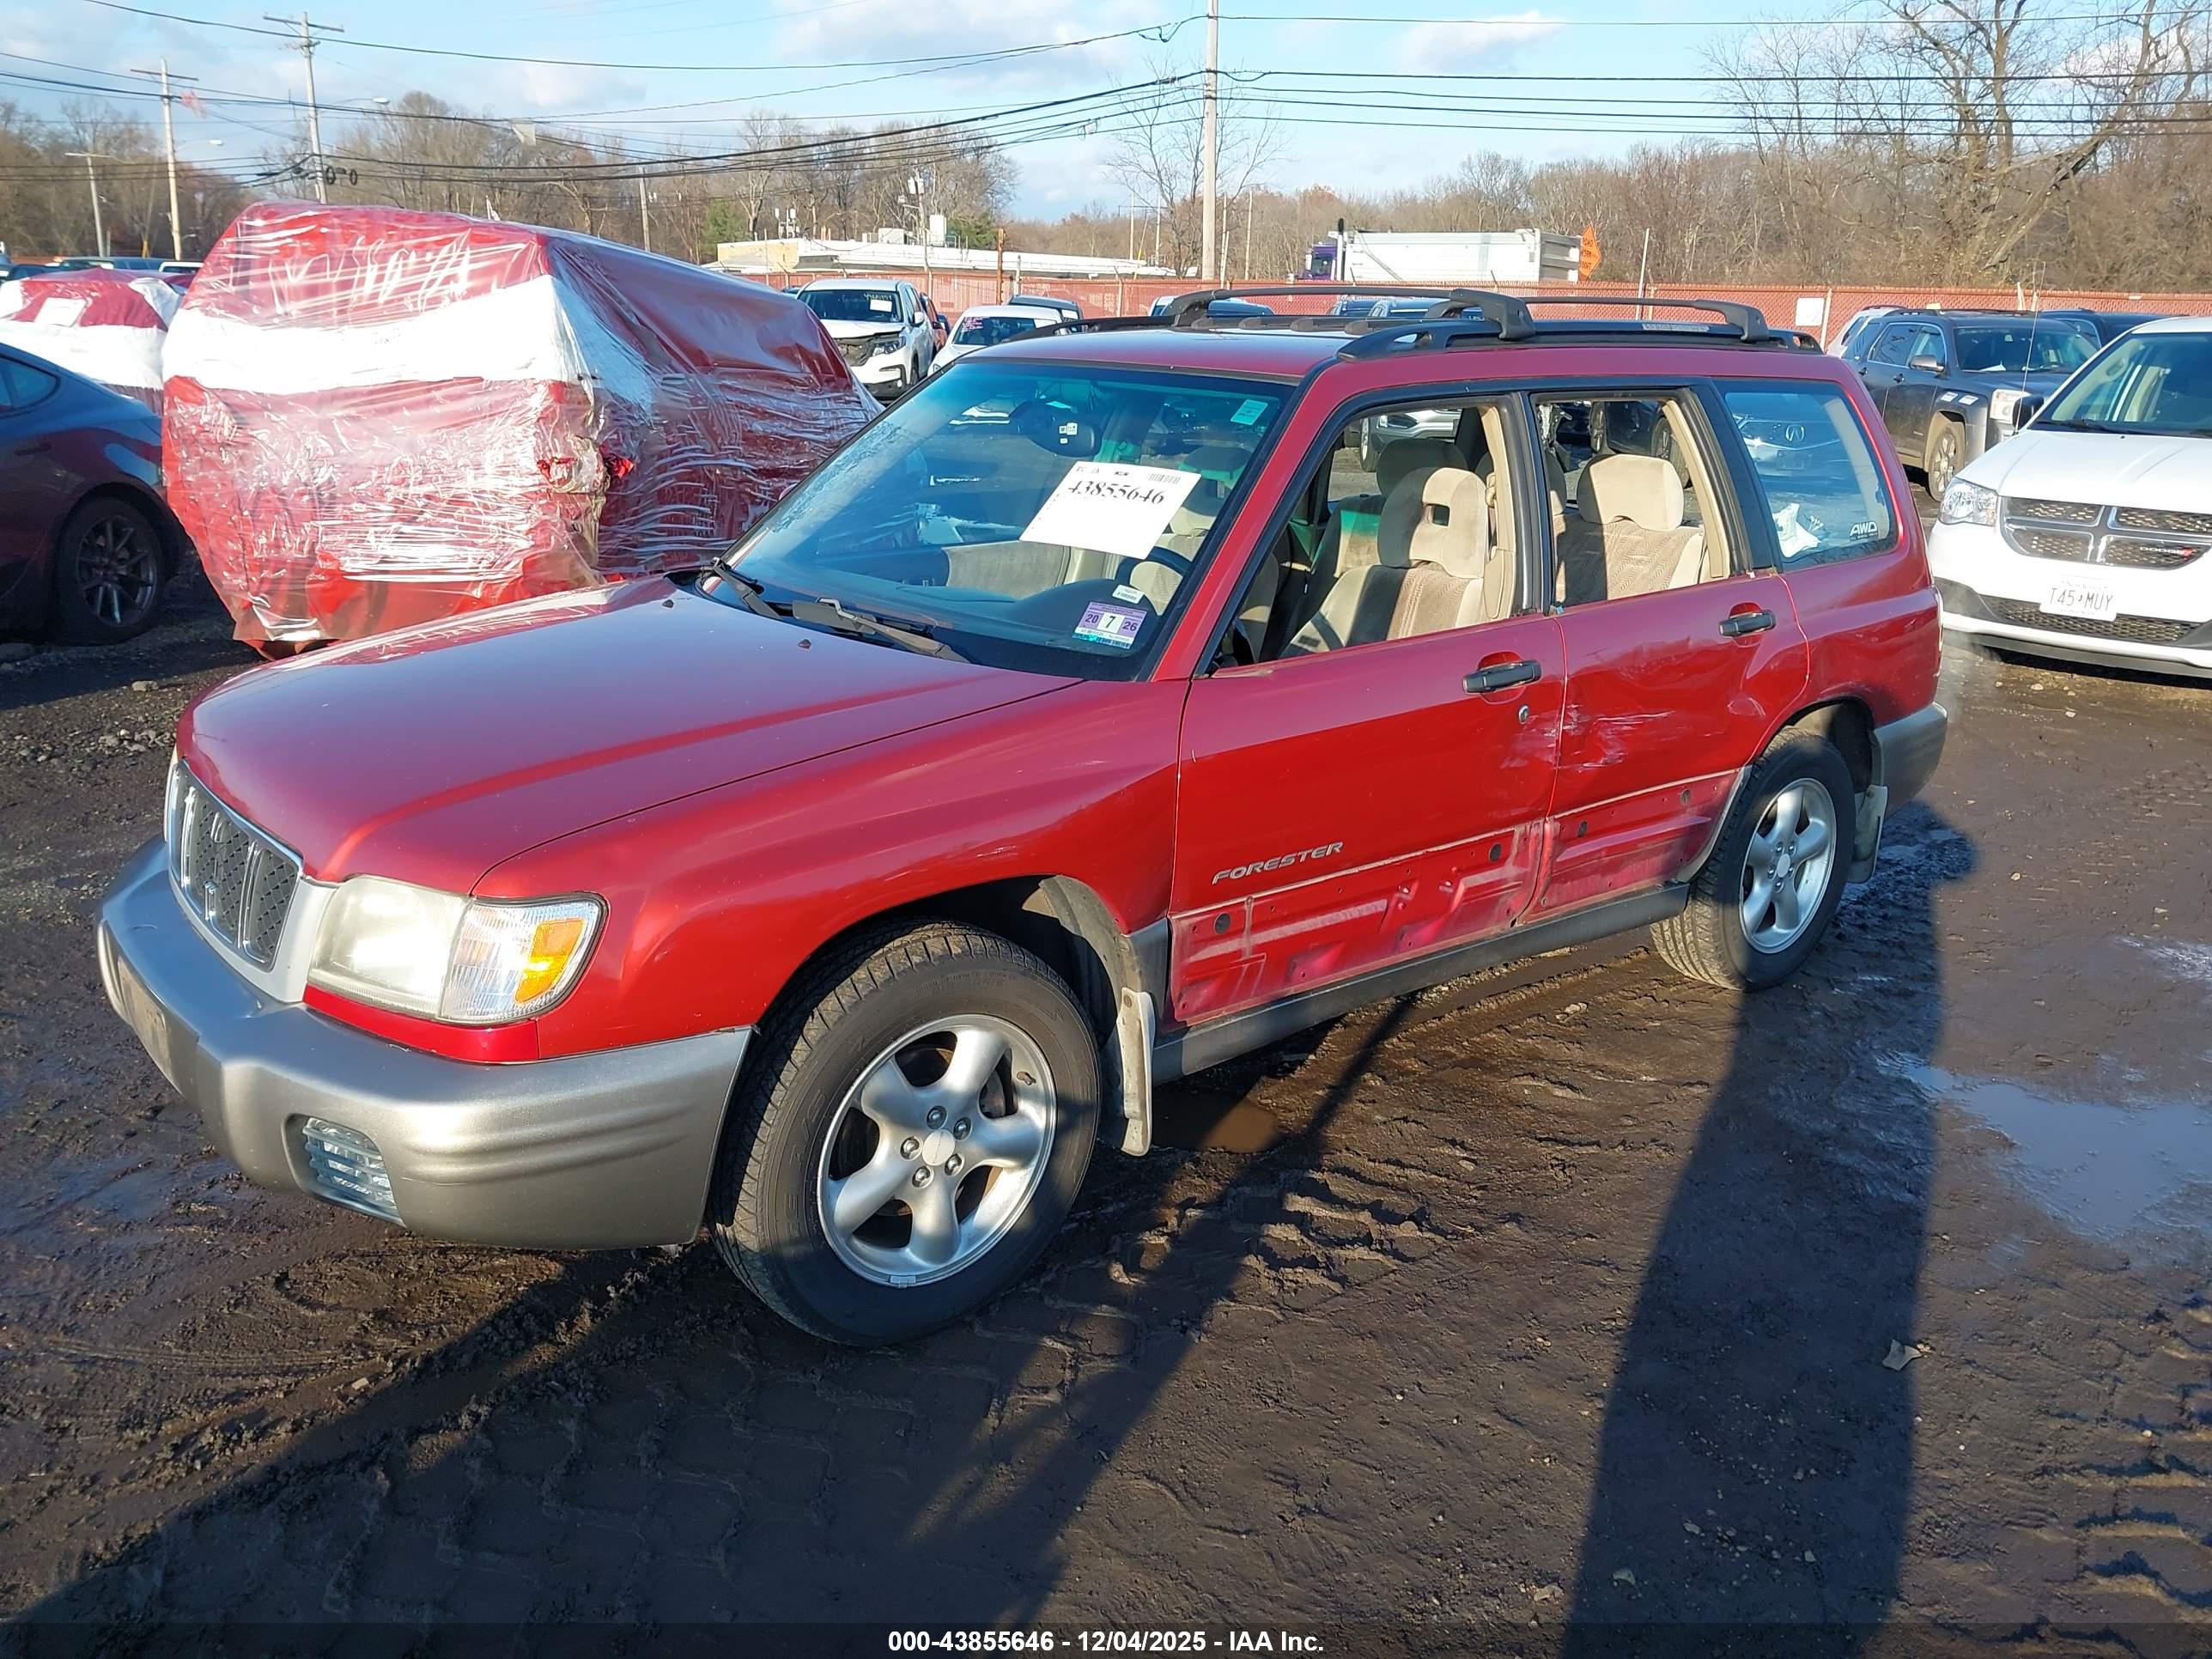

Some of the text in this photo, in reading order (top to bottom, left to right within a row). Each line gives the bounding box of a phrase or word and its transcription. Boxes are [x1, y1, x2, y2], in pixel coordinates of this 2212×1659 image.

[1068, 480, 1168, 504] 43855646
[1850, 521, 1878, 537] AWD
[1085, 613, 1138, 632] 20 7 26
[1212, 841, 1344, 885] FORESTER
